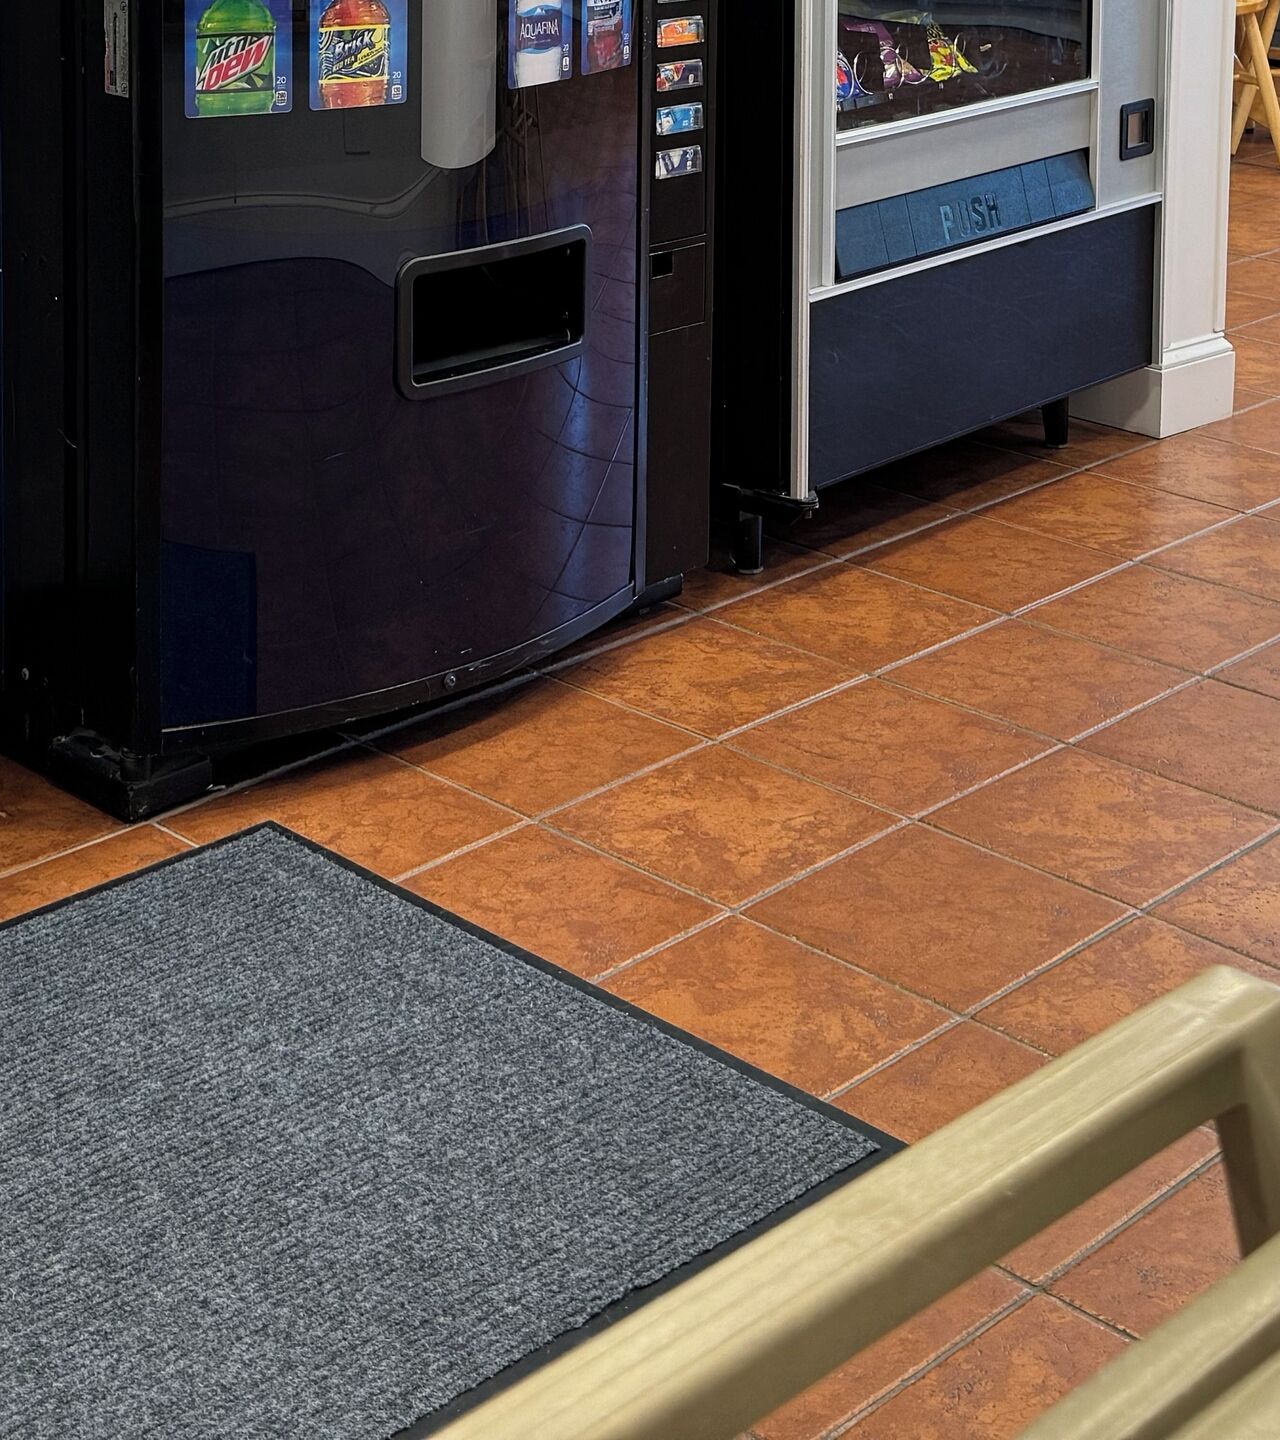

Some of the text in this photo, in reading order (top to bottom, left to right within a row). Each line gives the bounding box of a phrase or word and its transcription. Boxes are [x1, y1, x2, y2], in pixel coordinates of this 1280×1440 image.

[519, 18, 560, 40] AQUAFINA
[276, 76, 287, 85] 20
[392, 70, 402, 79] 20
[939, 190, 1002, 244] PUSH
